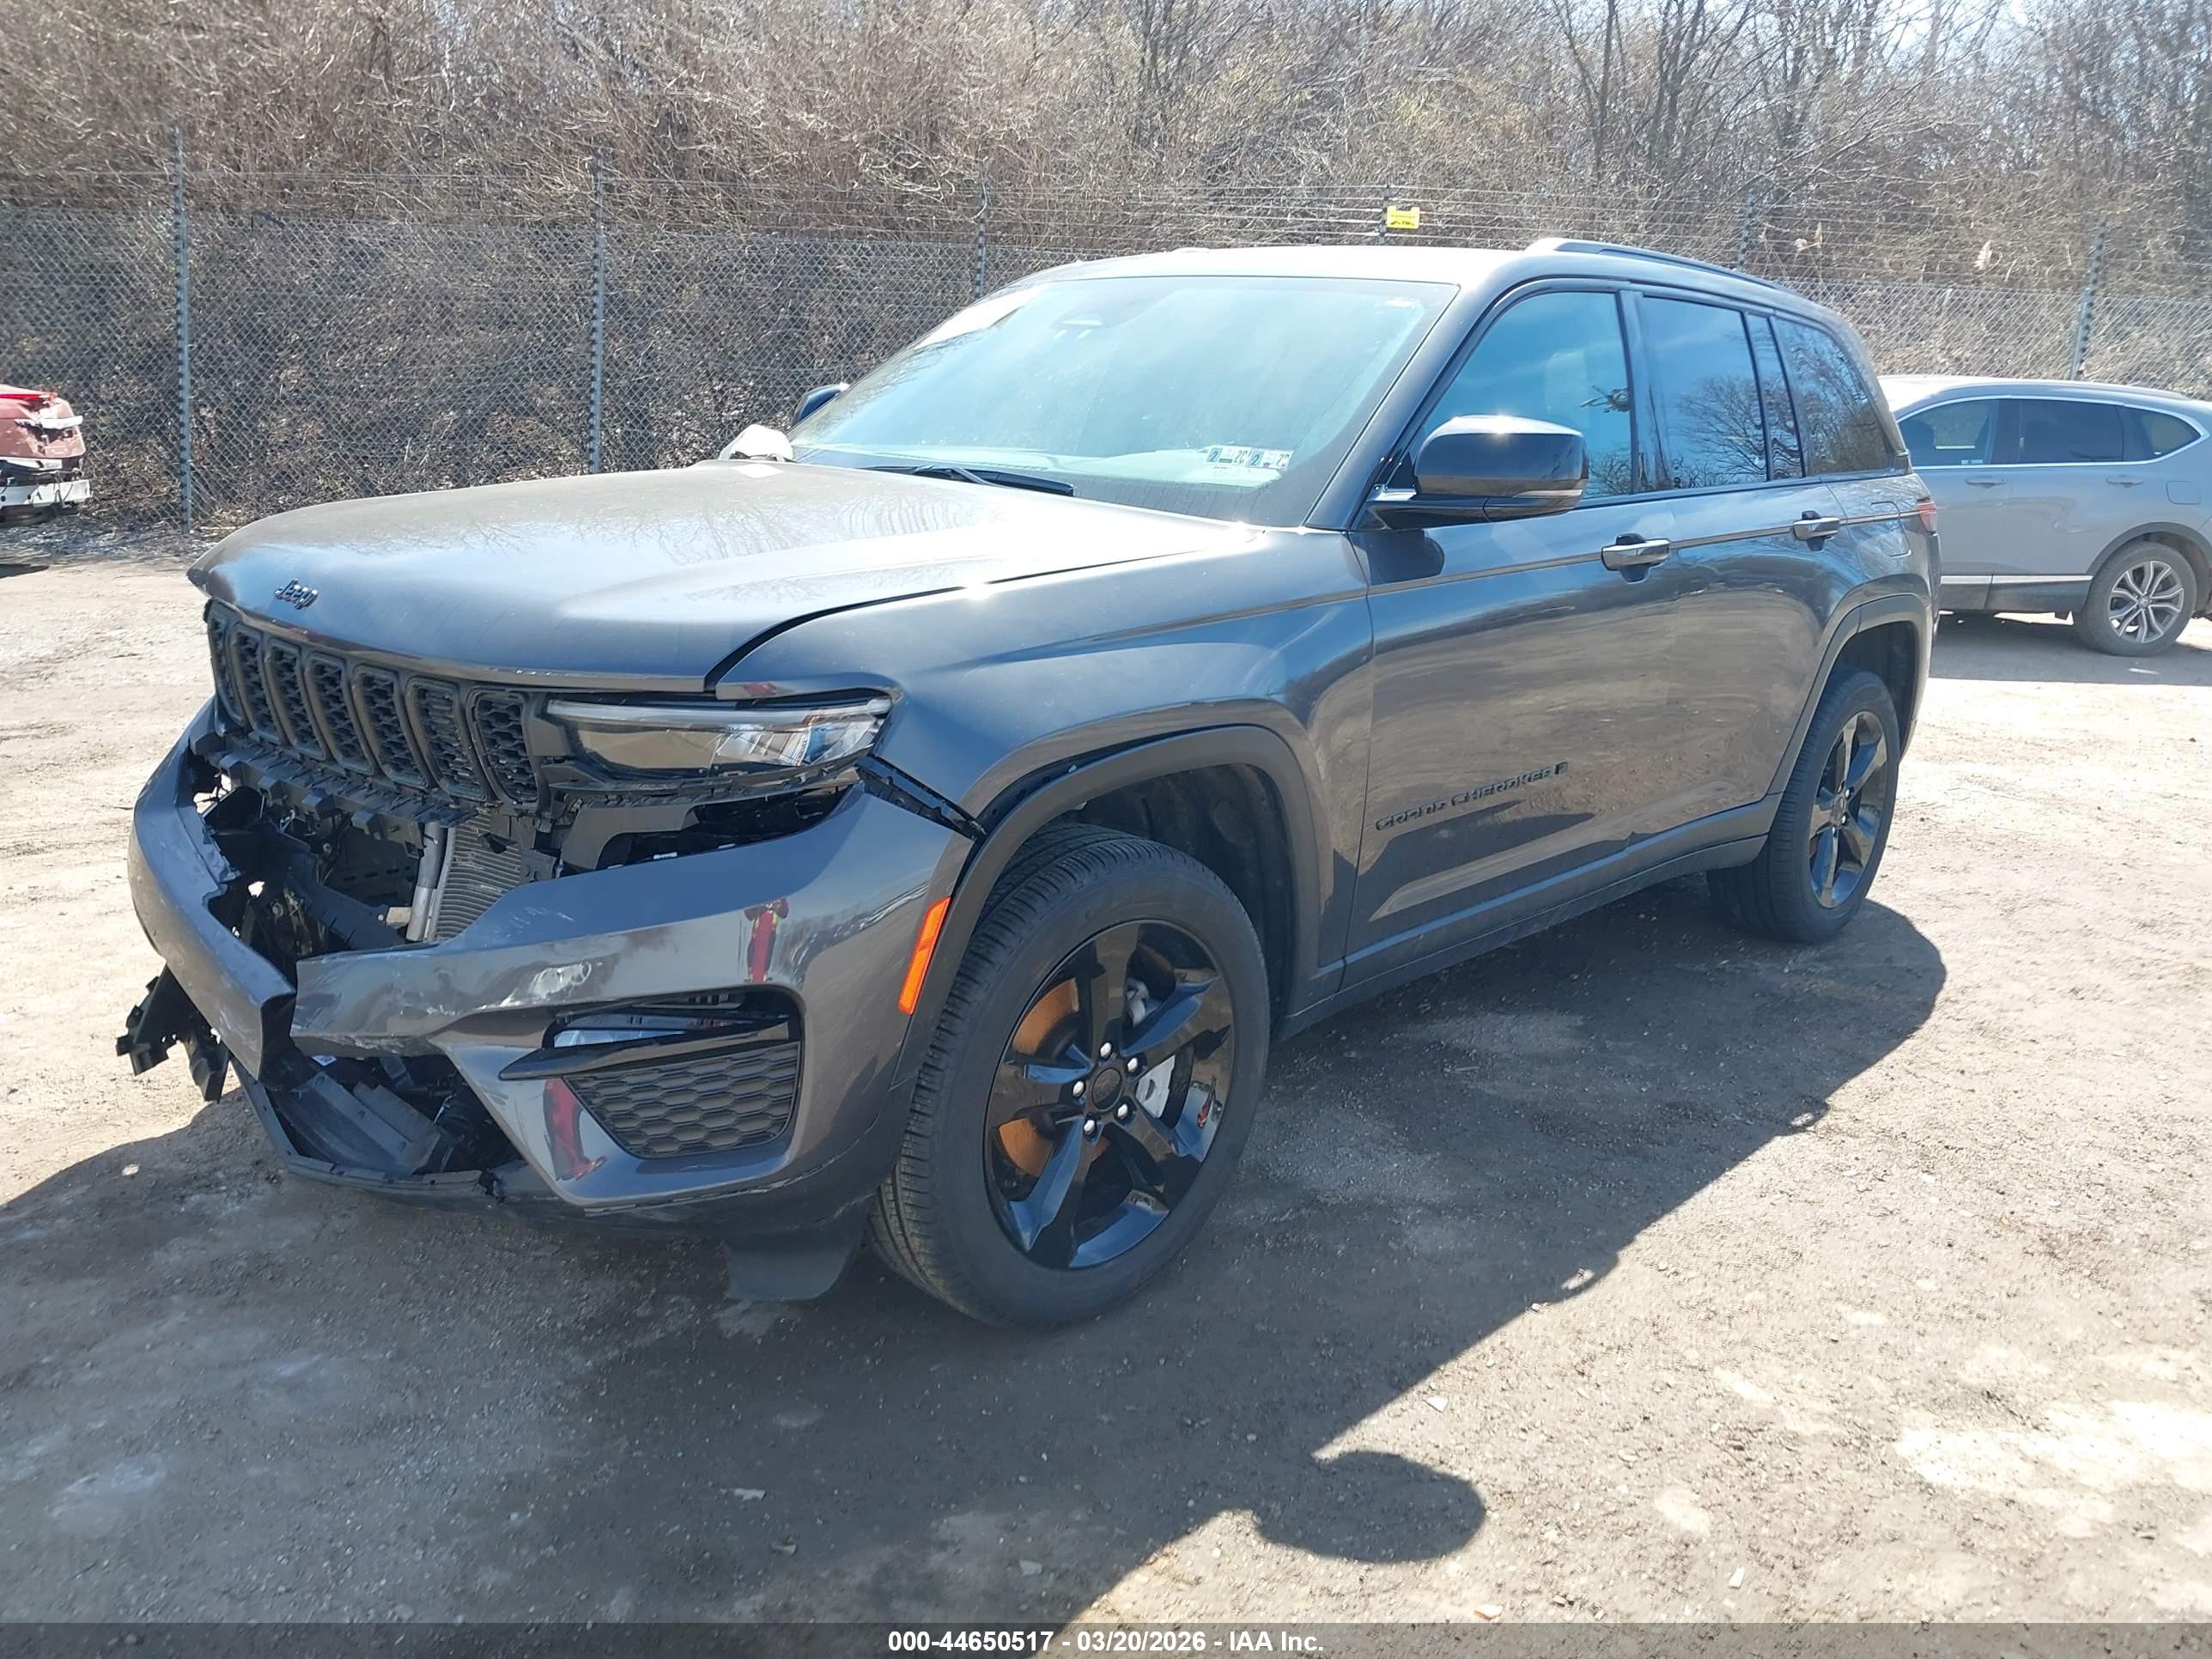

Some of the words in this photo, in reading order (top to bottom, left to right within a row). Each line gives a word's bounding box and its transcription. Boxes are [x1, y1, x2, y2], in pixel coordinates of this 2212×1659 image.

[275, 578, 319, 611] Jeep
[1375, 799, 1446, 831] GRAND
[1450, 765, 1553, 806] CHEROKEE
